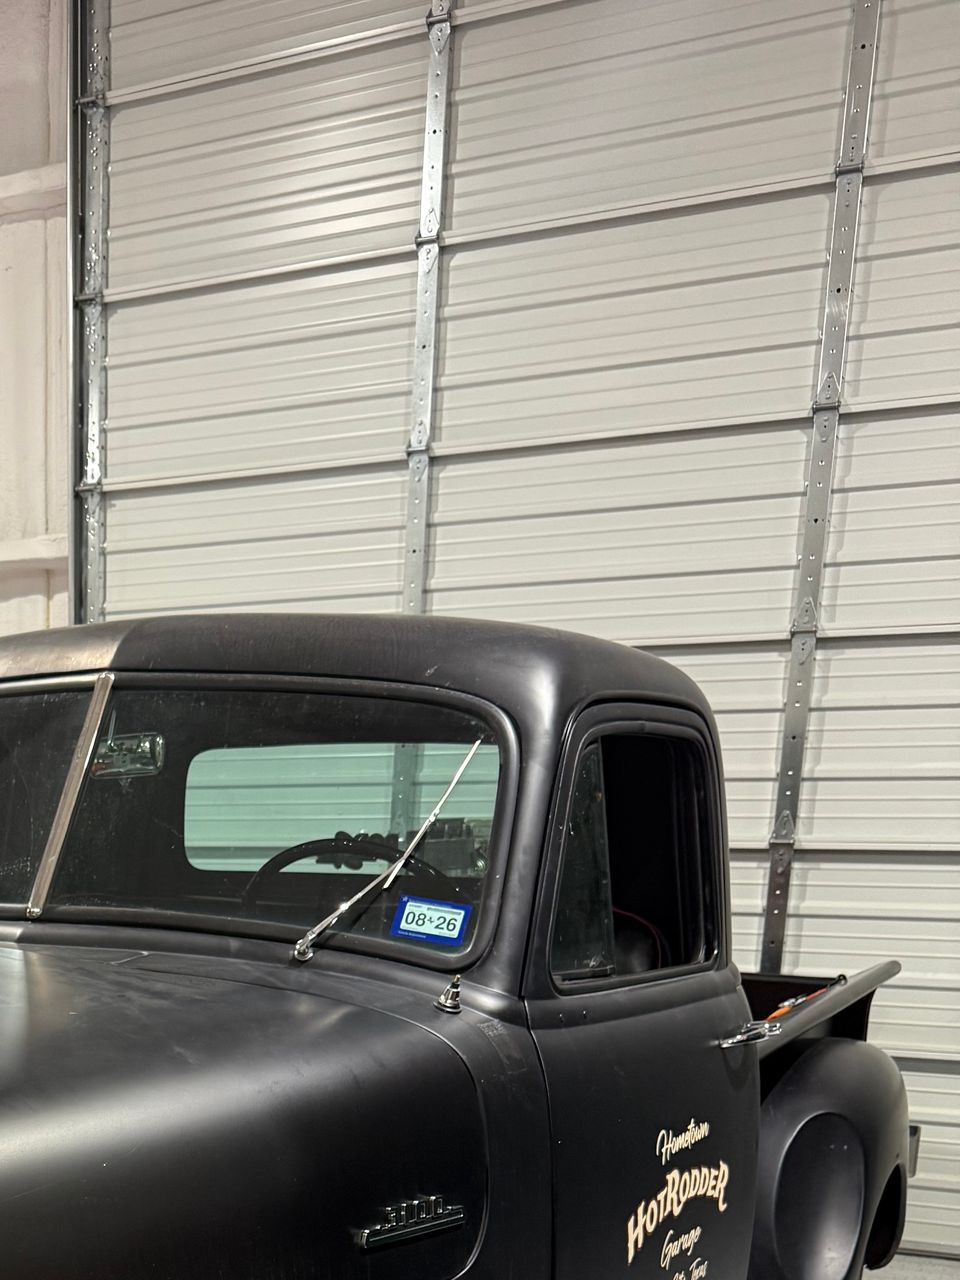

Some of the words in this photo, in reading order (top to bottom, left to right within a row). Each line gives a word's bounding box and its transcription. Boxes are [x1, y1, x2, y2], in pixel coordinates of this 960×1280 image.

[405, 911, 427, 927] 08
[434, 916, 458, 932] 26
[656, 1118, 710, 1166] Hometown
[660, 1225, 702, 1270] Garage
